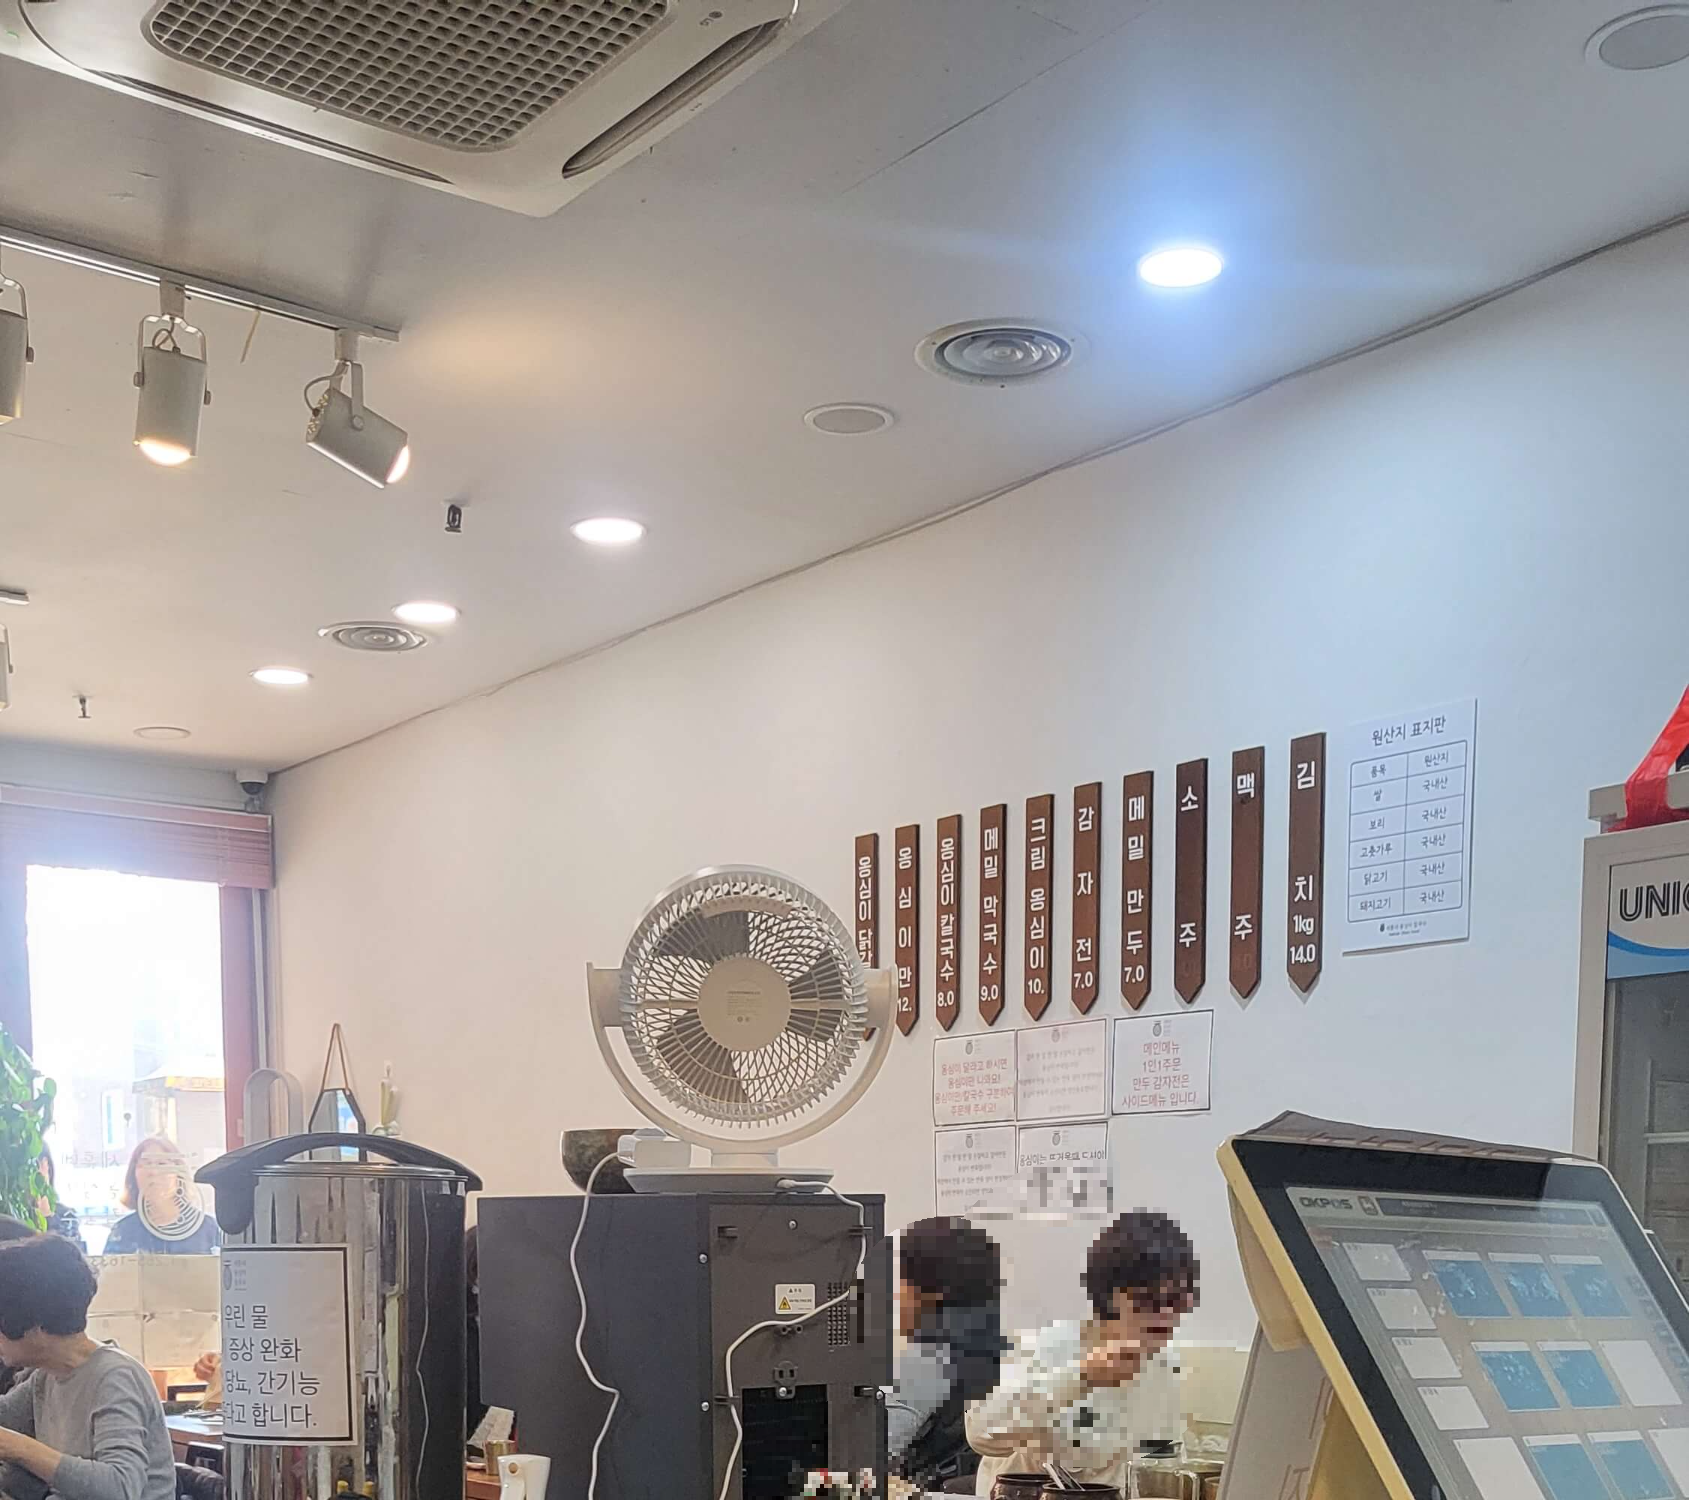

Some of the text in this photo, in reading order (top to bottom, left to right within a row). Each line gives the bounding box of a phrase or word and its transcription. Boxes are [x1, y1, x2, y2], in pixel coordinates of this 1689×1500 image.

[1372, 715, 1446, 746] 원산지 표지판
[1424, 750, 1449, 767] 원산지
[1371, 764, 1386, 778] 품목
[1422, 776, 1448, 792] 국내산
[1373, 788, 1382, 801] 쌀
[1422, 806, 1446, 821] 국내산
[1368, 817, 1385, 830] 보리
[1030, 817, 1046, 871] 크림
[1420, 833, 1446, 849] 국내산
[1360, 842, 1393, 858] 고춧가루
[1420, 861, 1445, 876] 국내산
[1363, 870, 1388, 886] 닭고기
[858, 856, 872, 922] 옹심이
[1420, 889, 1444, 904] 국내산
[1359, 897, 1391, 912] 돼지고기
[937, 837, 955, 1007] 옹심이 칼국수 8.0
[980, 827, 999, 1001] 메밀 막국수 9.0
[1029, 887, 1046, 970] 옹심이
[1292, 914, 1314, 935] 1kg
[1289, 943, 1316, 966] 14.0
[1073, 971, 1094, 990] 7.0
[1124, 964, 1145, 984] 7.0
[1143, 1041, 1180, 1055] 메인메뉴
[1143, 1057, 1182, 1073] 1인1주문
[1133, 1074, 1190, 1091] 만두 감자전은
[1121, 1094, 1166, 1108] 사이드메뉴
[1299, 1195, 1353, 1210] OKPOS
[251, 1305, 268, 1330] 물
[229, 1337, 302, 1362] 증상 완화
[258, 1370, 320, 1396] 간기능
[223, 1401, 317, 1429] 다고 합니다.
